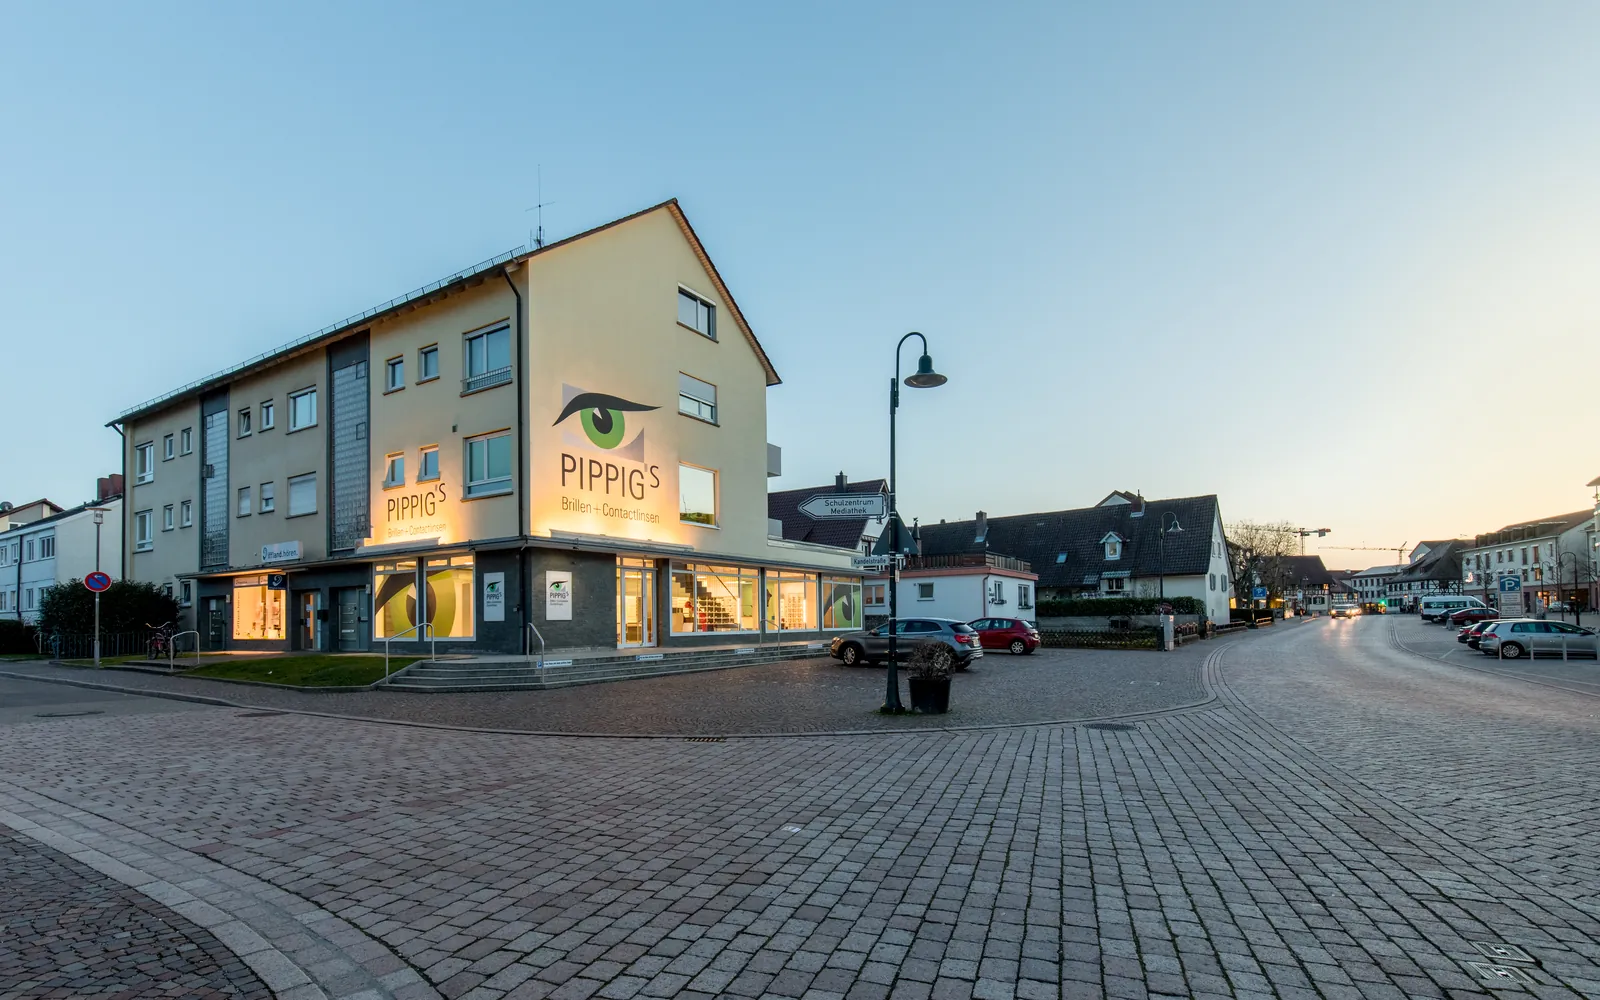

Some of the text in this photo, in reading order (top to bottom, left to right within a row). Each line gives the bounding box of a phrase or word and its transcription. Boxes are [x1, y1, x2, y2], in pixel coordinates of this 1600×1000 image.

[561, 453, 660, 500] PIPPIG'S
[388, 483, 446, 522] PIPPIG'S
[562, 496, 592, 514] Brillen
[602, 503, 660, 524] Contactlinsen
[1505, 580, 1515, 590] P
